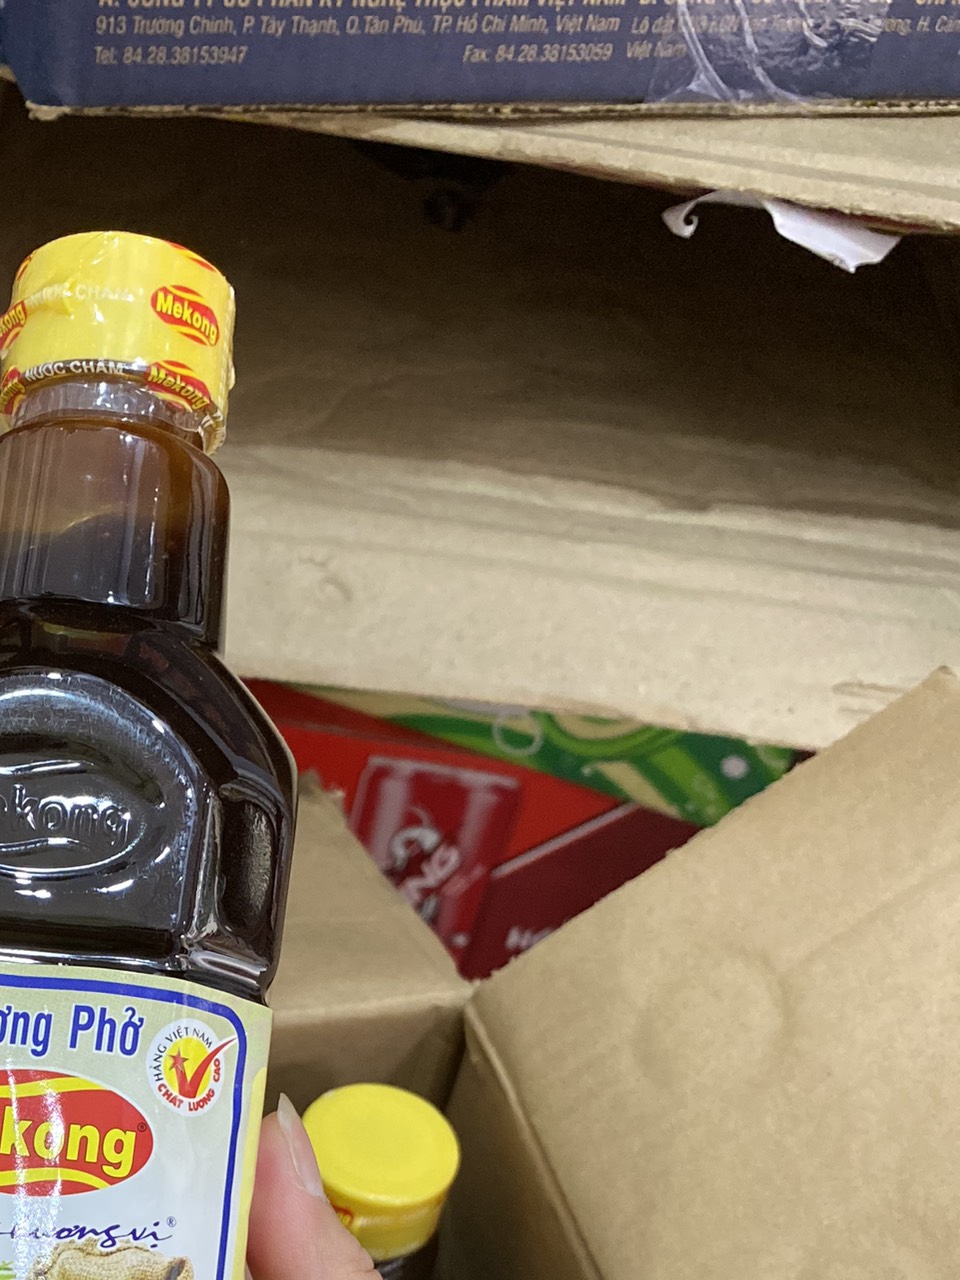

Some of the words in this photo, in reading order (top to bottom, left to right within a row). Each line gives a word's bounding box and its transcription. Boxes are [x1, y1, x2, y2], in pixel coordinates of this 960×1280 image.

[96, 15, 127, 34] 913
[586, 13, 622, 32] Nam
[155, 291, 218, 346] Mekong
[147, 364, 210, 410] Mekong
[68, 1003, 145, 1057] Phở
[192, 1028, 213, 1049] NAM
[213, 1058, 222, 1083] CAO
